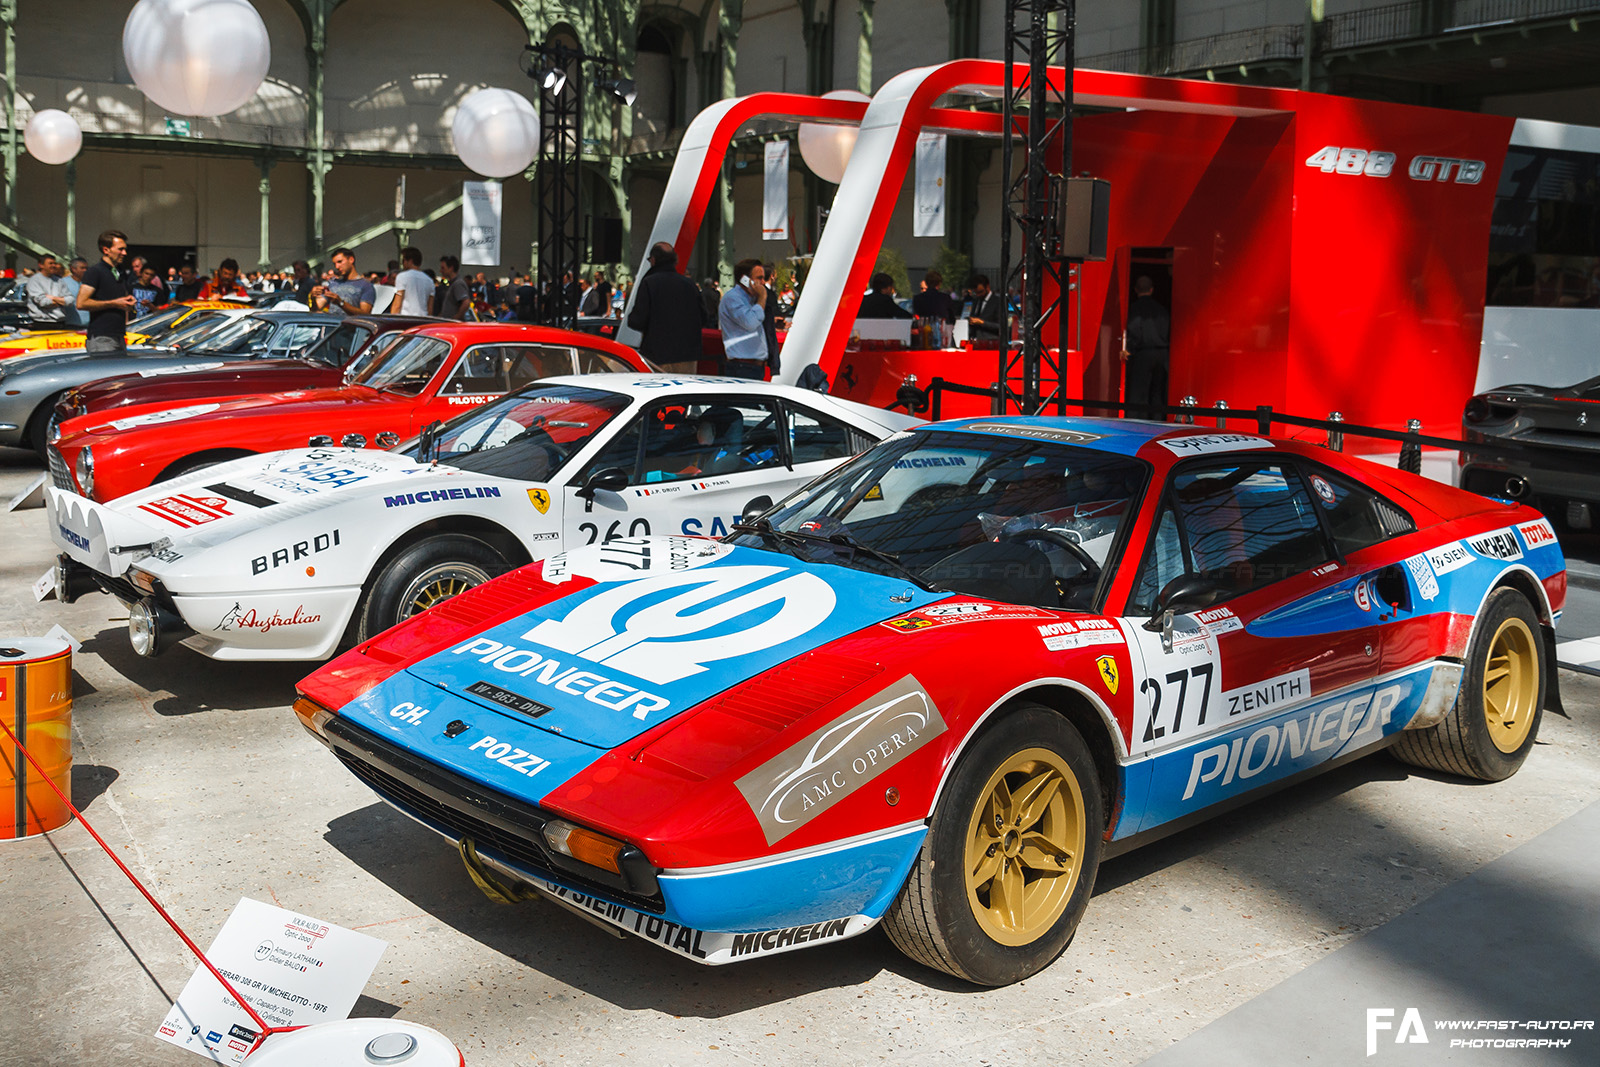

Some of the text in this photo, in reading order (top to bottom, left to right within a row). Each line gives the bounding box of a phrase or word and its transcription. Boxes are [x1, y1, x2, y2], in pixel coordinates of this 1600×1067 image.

[1306, 146, 1486, 185] 488 GTB
[448, 396, 486, 405] PILOTO:
[983, 425, 1071, 441] AMC OPERA
[279, 462, 369, 489] SABA
[894, 456, 967, 470] MICHELIN
[384, 486, 501, 508] MICHELIN
[59, 524, 90, 553] MICHELIN
[1471, 532, 1521, 560] MICHELIN
[1521, 523, 1554, 545] TOTAL
[251, 529, 341, 576] BARDI
[1445, 547, 1468, 564] SIEM
[237, 604, 321, 633] Australian
[932, 605, 979, 615] 277
[1198, 607, 1234, 623] MOTUL
[1037, 622, 1078, 637] MOTUL
[1075, 619, 1114, 630] MOTUL
[1179, 643, 1206, 655] Optic 2000
[451, 637, 671, 720] PIONEER
[1140, 662, 1214, 743] 277
[1228, 677, 1302, 716] ZENITH
[389, 701, 430, 726] CH.
[1181, 684, 1403, 801] PIONEER
[469, 735, 551, 777] POZZI
[801, 725, 919, 811] AMC OPERA
[571, 888, 626, 923] SIEM
[632, 911, 707, 959] TOTAL
[730, 917, 851, 958] MICHELIN
[257, 945, 270, 955] 277
[293, 953, 317, 965] LATHAM
[251, 981, 263, 990] GR
[261, 984, 270, 992] IV
[268, 986, 309, 1007] MICHELOTTO
[312, 1002, 329, 1014] 1976
[278, 1007, 294, 1017] 3000
[164, 1020, 183, 1031] ZENITH
